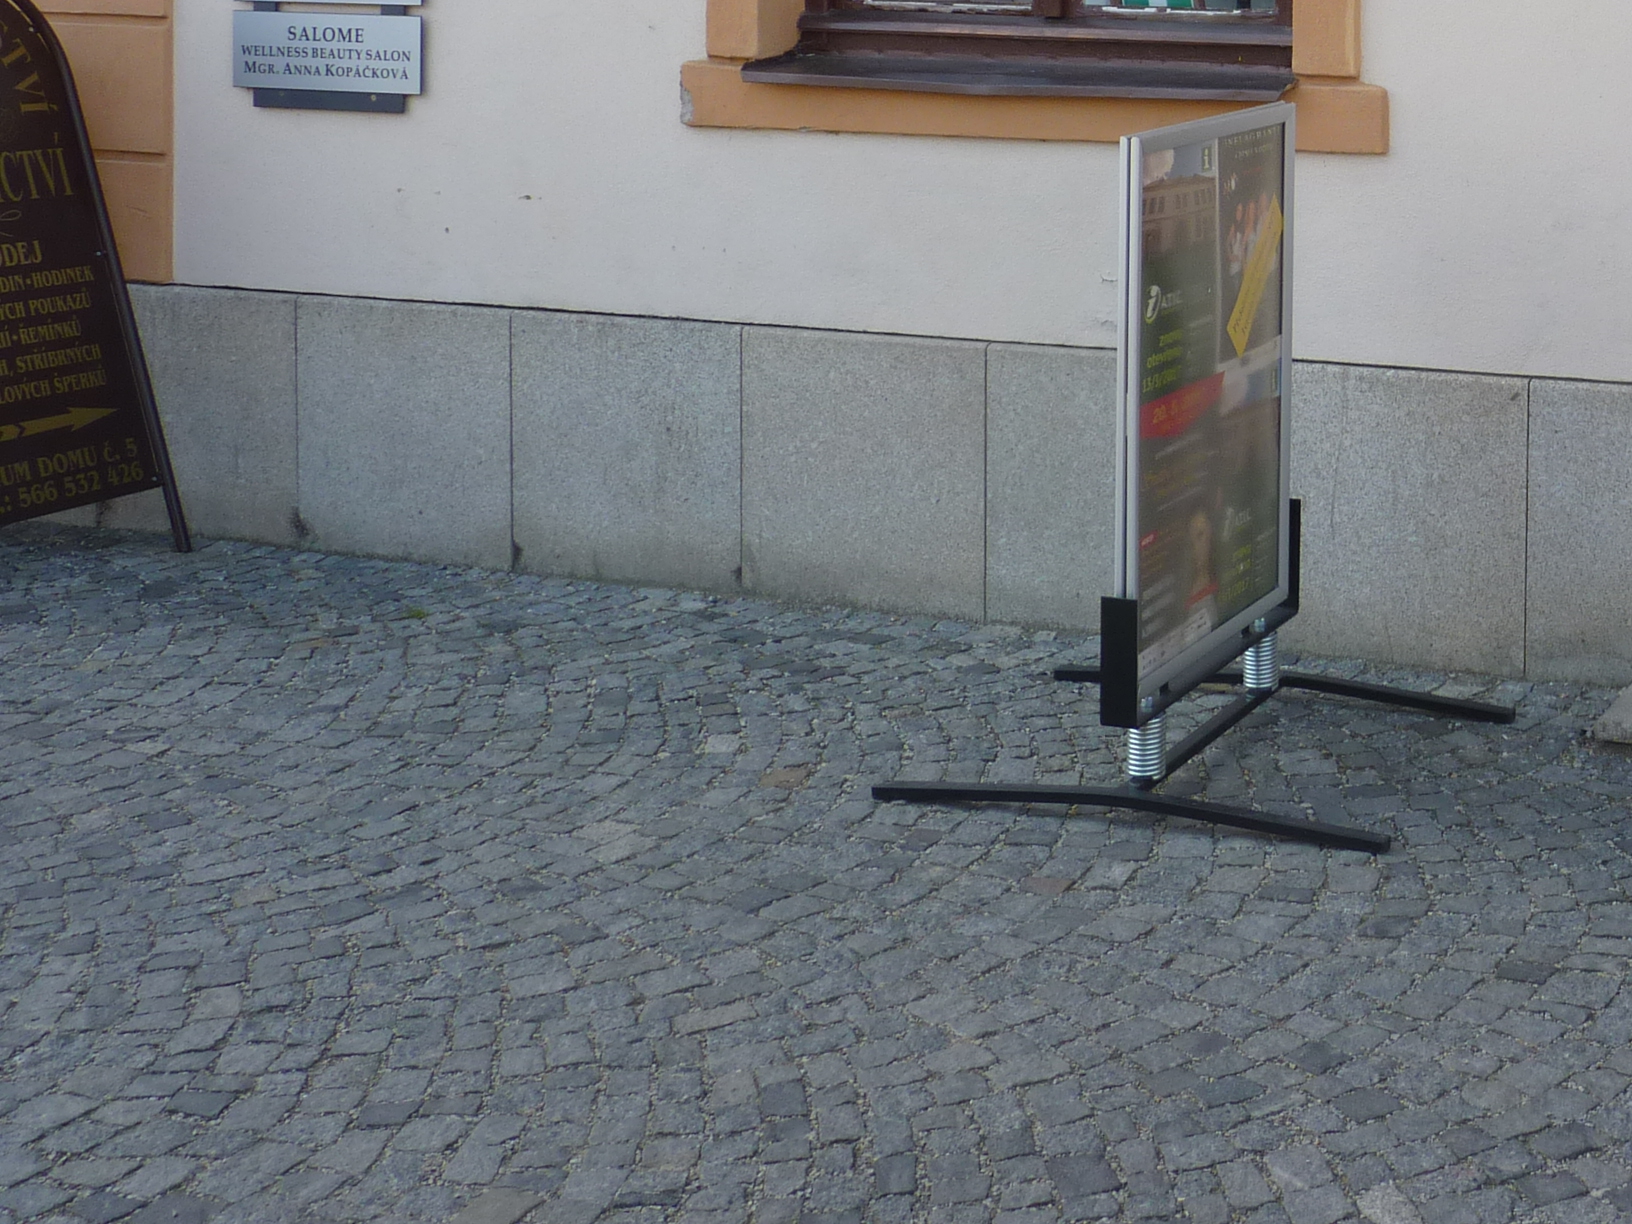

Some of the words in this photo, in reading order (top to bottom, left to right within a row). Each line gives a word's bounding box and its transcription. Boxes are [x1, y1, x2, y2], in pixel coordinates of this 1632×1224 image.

[287, 26, 365, 43] SALOME
[241, 45, 309, 58] WELLNESS
[312, 47, 363, 60] BEAUTY
[366, 50, 411, 62] SALON
[0, 240, 43, 267] DEJ
[28, 287, 92, 317] POUKAZŮ
[16, 341, 102, 374] STŘÍBRNÝCH
[54, 365, 107, 394] ŠPERKŮ
[36, 445, 98, 477] DOMU
[125, 438, 138, 457] 5
[18, 480, 58, 508] 566
[64, 470, 101, 497] 532
[107, 461, 144, 486] 426
